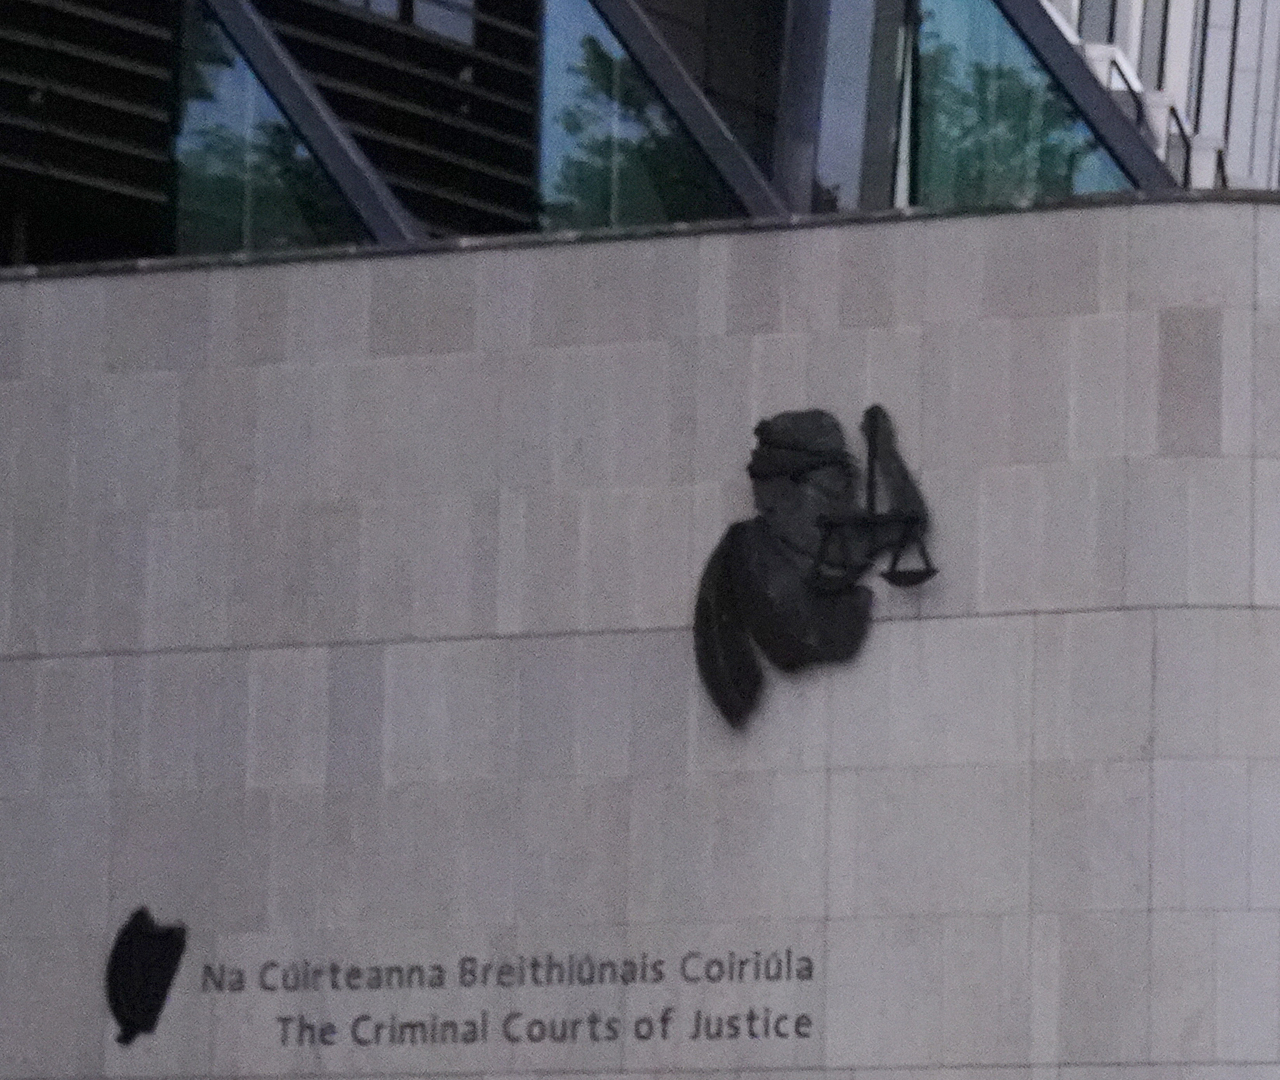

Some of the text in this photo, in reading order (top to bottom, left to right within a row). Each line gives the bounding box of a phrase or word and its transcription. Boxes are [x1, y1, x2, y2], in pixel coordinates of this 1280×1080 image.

[202, 947, 814, 992] Na Cúirteanna Breithiúnais Coiriúla
[276, 1006, 813, 1047] The Criminal Courts of Justice
